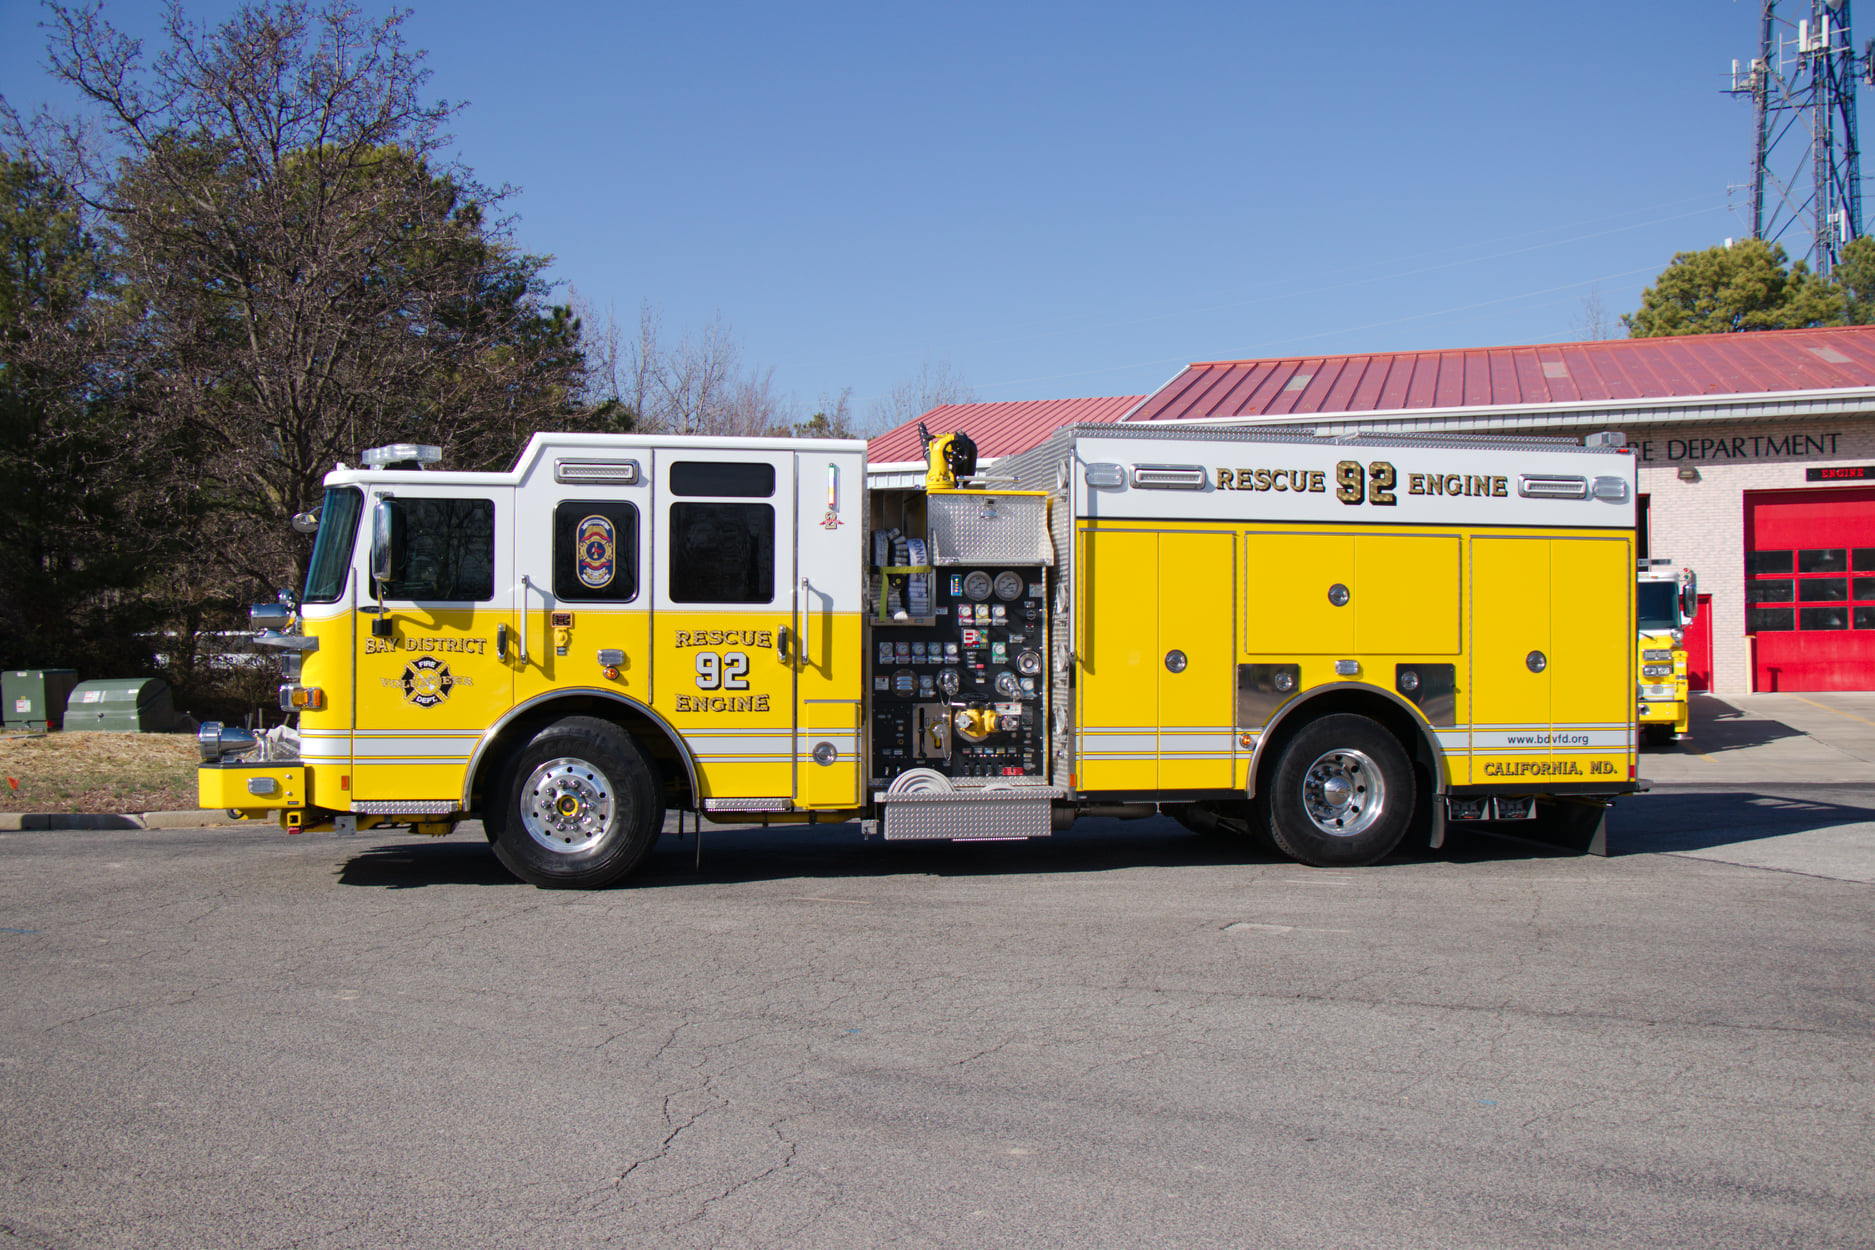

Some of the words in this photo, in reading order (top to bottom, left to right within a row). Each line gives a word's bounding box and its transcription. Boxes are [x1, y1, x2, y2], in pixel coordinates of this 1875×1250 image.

[1667, 433, 1842, 460] DEPARTMENT
[1821, 468, 1864, 478] ENGINE
[1216, 467, 1326, 492] RESCUE
[1336, 460, 1397, 506] 92
[1408, 473, 1508, 497] ENGINE
[365, 637, 399, 654] BAY
[406, 637, 487, 654] DISTRICT
[675, 630, 772, 648] RESCUE
[418, 660, 437, 668] FIRE
[696, 652, 750, 691] 92
[416, 695, 437, 704] DEPT.
[675, 693, 770, 713] ENGINE
[1507, 734, 1589, 745] www.bdvfd.org
[1484, 761, 1583, 776] CALIFORNIA,
[1590, 760, 1618, 774] MD.
